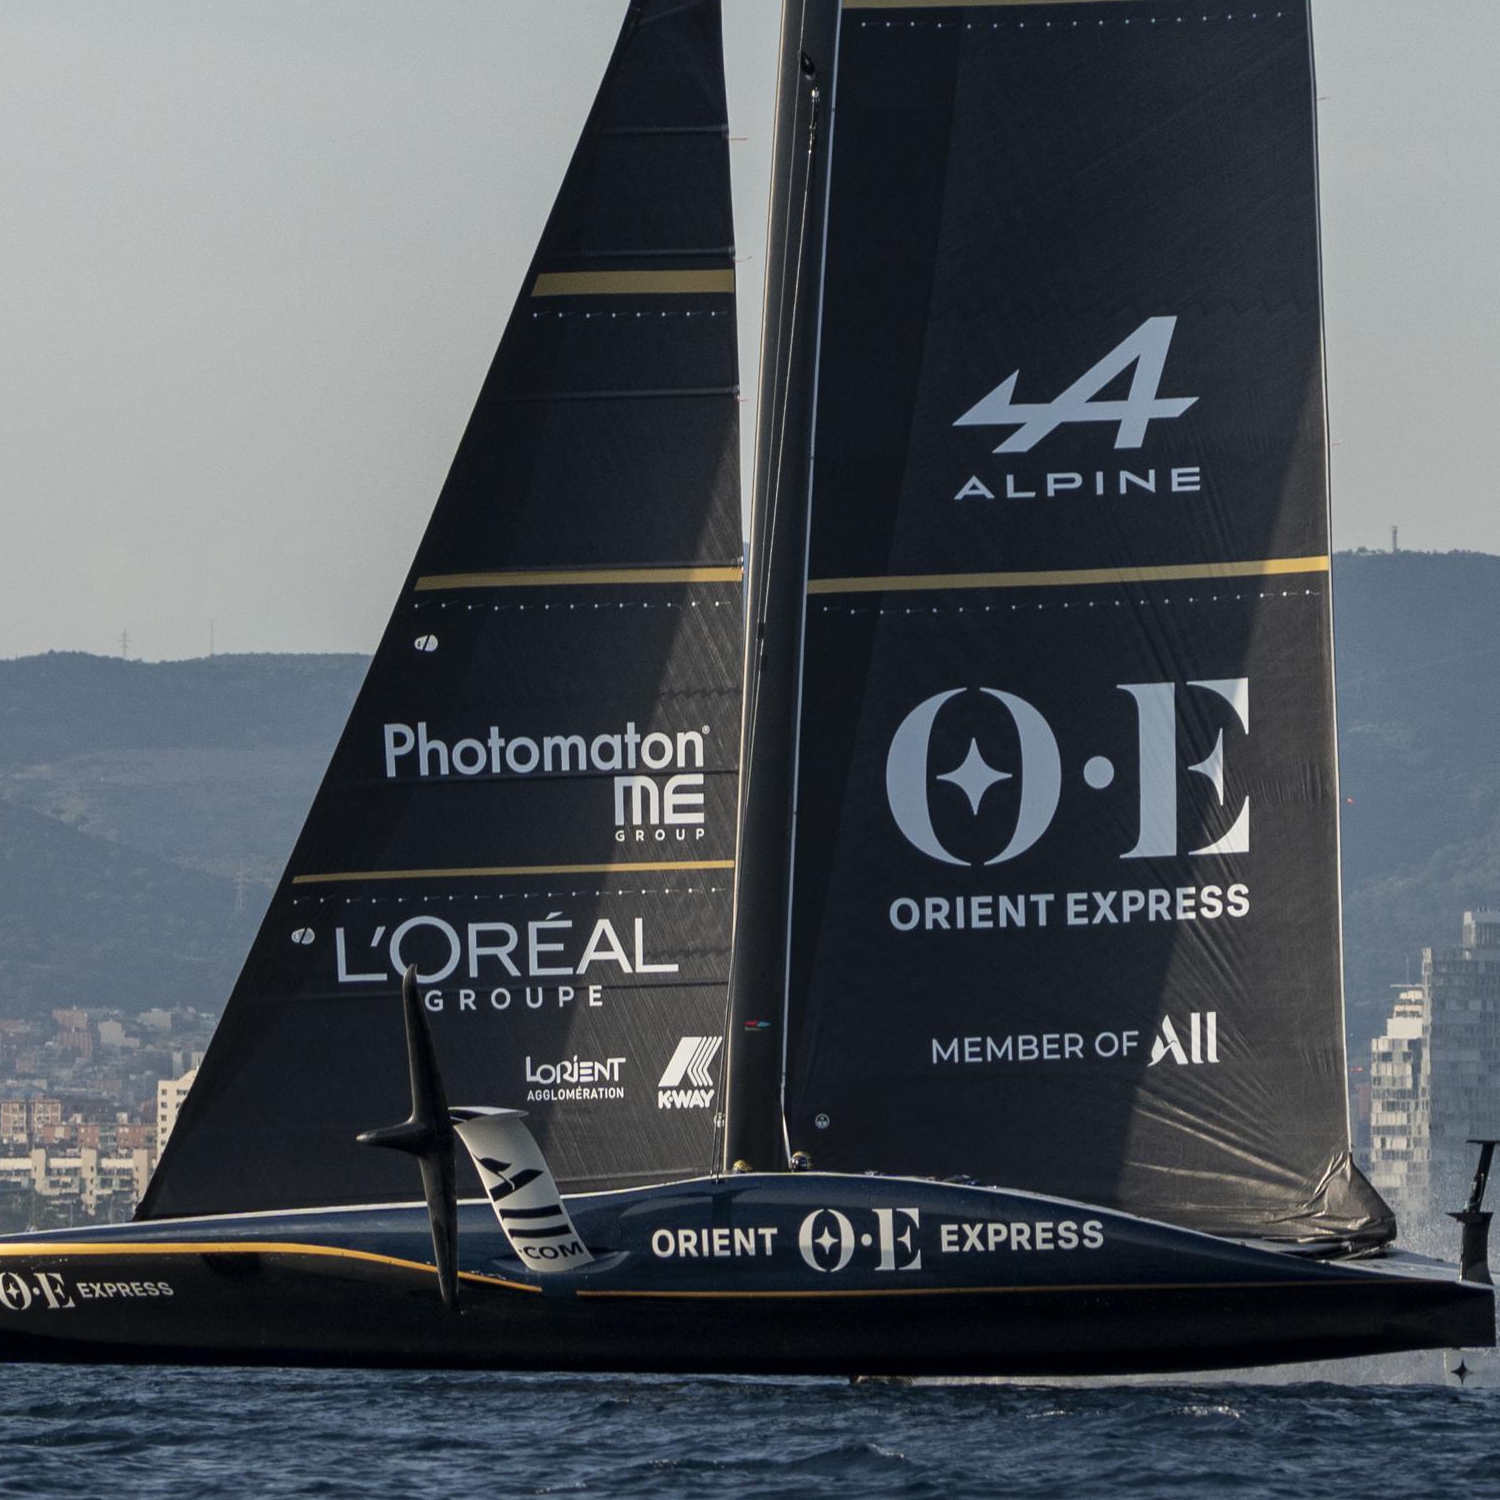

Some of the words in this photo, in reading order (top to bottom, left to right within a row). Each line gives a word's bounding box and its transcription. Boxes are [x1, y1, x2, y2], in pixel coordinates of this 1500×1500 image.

[953, 466, 1201, 500] ALPINE
[615, 827, 705, 842] GROUP
[889, 893, 1055, 931] ORIENT
[1067, 883, 1250, 925] EXPRESS
[335, 911, 680, 984] L'ORÉAL
[425, 985, 604, 1012] GROUPE
[931, 1030, 1084, 1064] MEMBER
[1094, 1030, 1139, 1058] OF
[526, 1086, 625, 1101] AGGLOMÉRATION
[651, 1227, 778, 1258] ORIENT
[940, 1220, 1104, 1253] EXPRESS
[76, 1281, 174, 1299] EXPRESS
